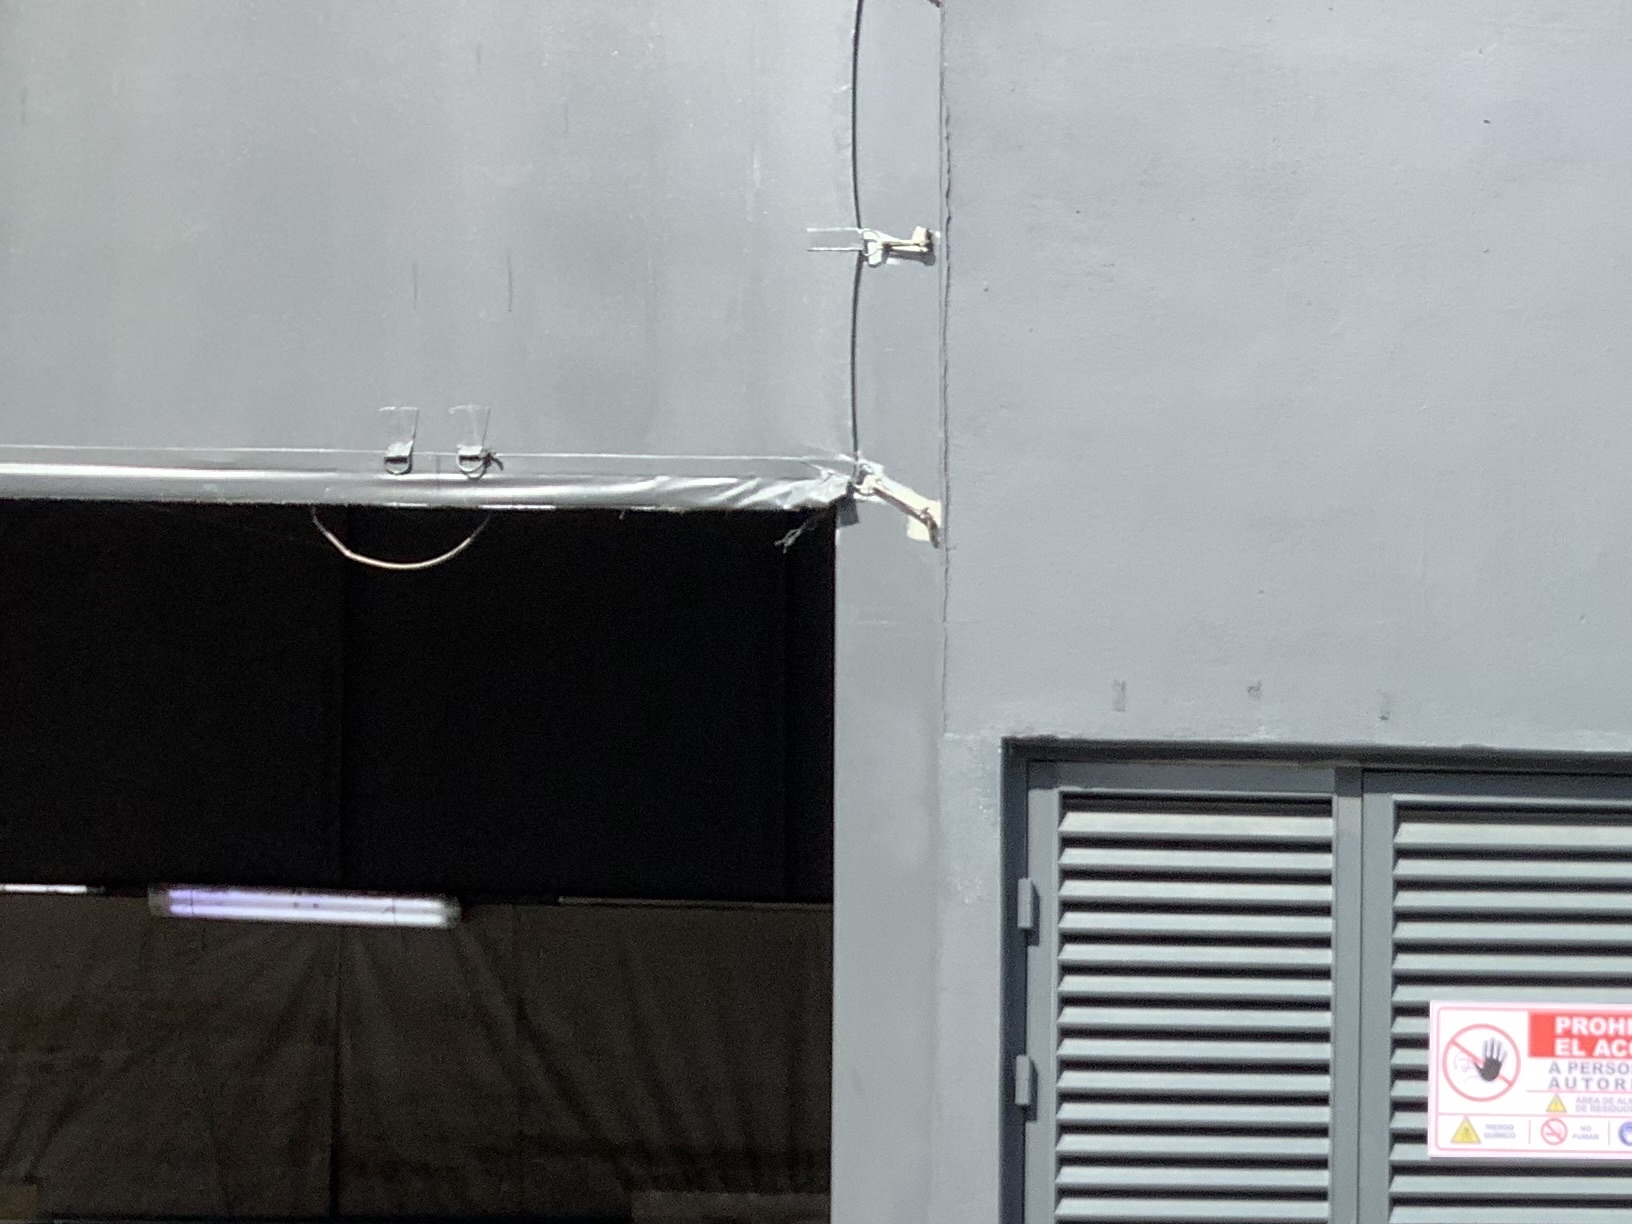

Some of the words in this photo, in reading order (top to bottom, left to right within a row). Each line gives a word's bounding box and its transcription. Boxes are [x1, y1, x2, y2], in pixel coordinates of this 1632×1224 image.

[1554, 1038, 1586, 1056] EL
[1548, 1060, 1562, 1075] A
[1602, 1096, 1614, 1105] DE
[1575, 1104, 1587, 1112] DE
